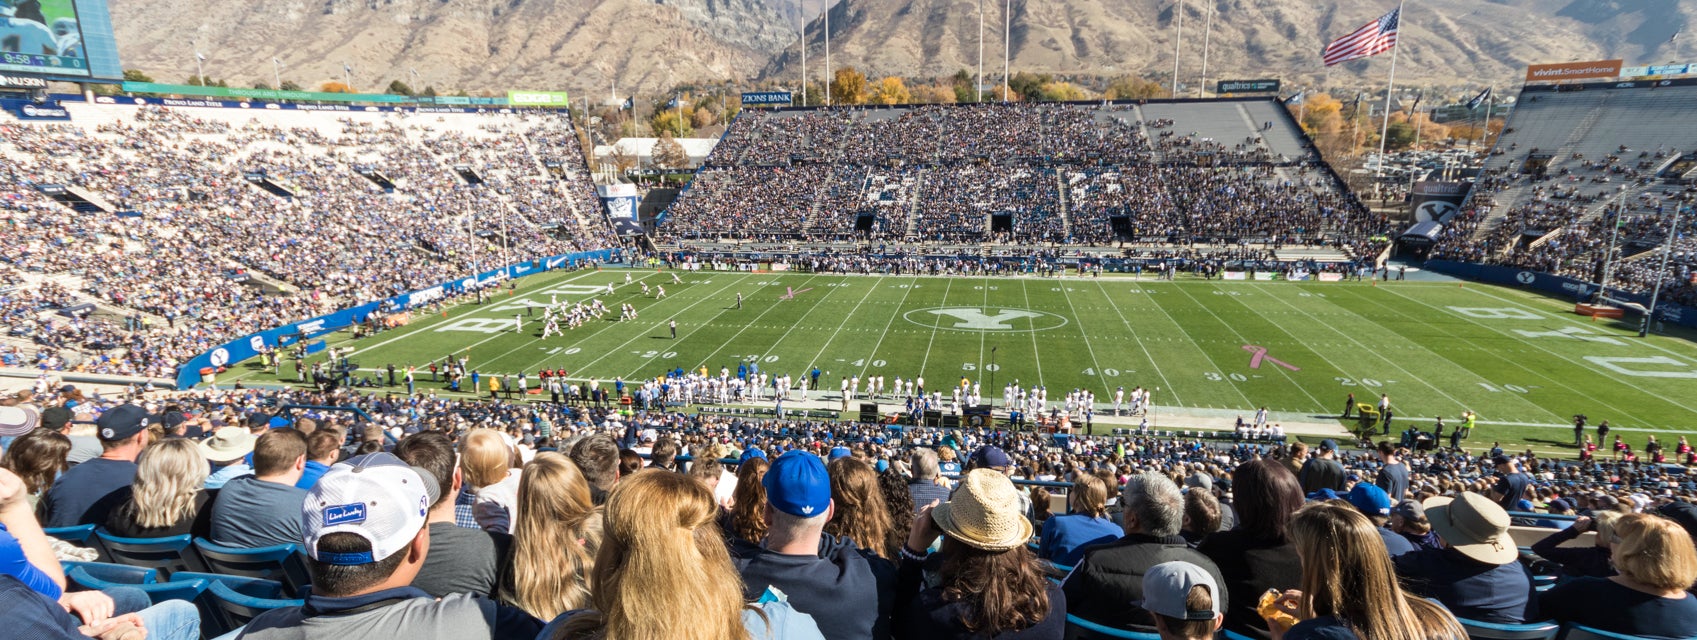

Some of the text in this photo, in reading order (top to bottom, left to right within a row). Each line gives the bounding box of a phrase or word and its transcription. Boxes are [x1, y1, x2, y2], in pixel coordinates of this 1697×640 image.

[4, 54, 31, 65] 9:58
[1222, 81, 1251, 91] qualtrics
[743, 94, 791, 102] ZIONS BANK
[546, 347, 582, 355] 10
[639, 350, 678, 358] 20
[851, 358, 887, 368] 40
[962, 362, 1000, 372] 50
[1081, 367, 1120, 377] 40
[1203, 372, 1248, 383] 30
[1334, 376, 1384, 388] 20
[1477, 382, 1529, 393] 10
